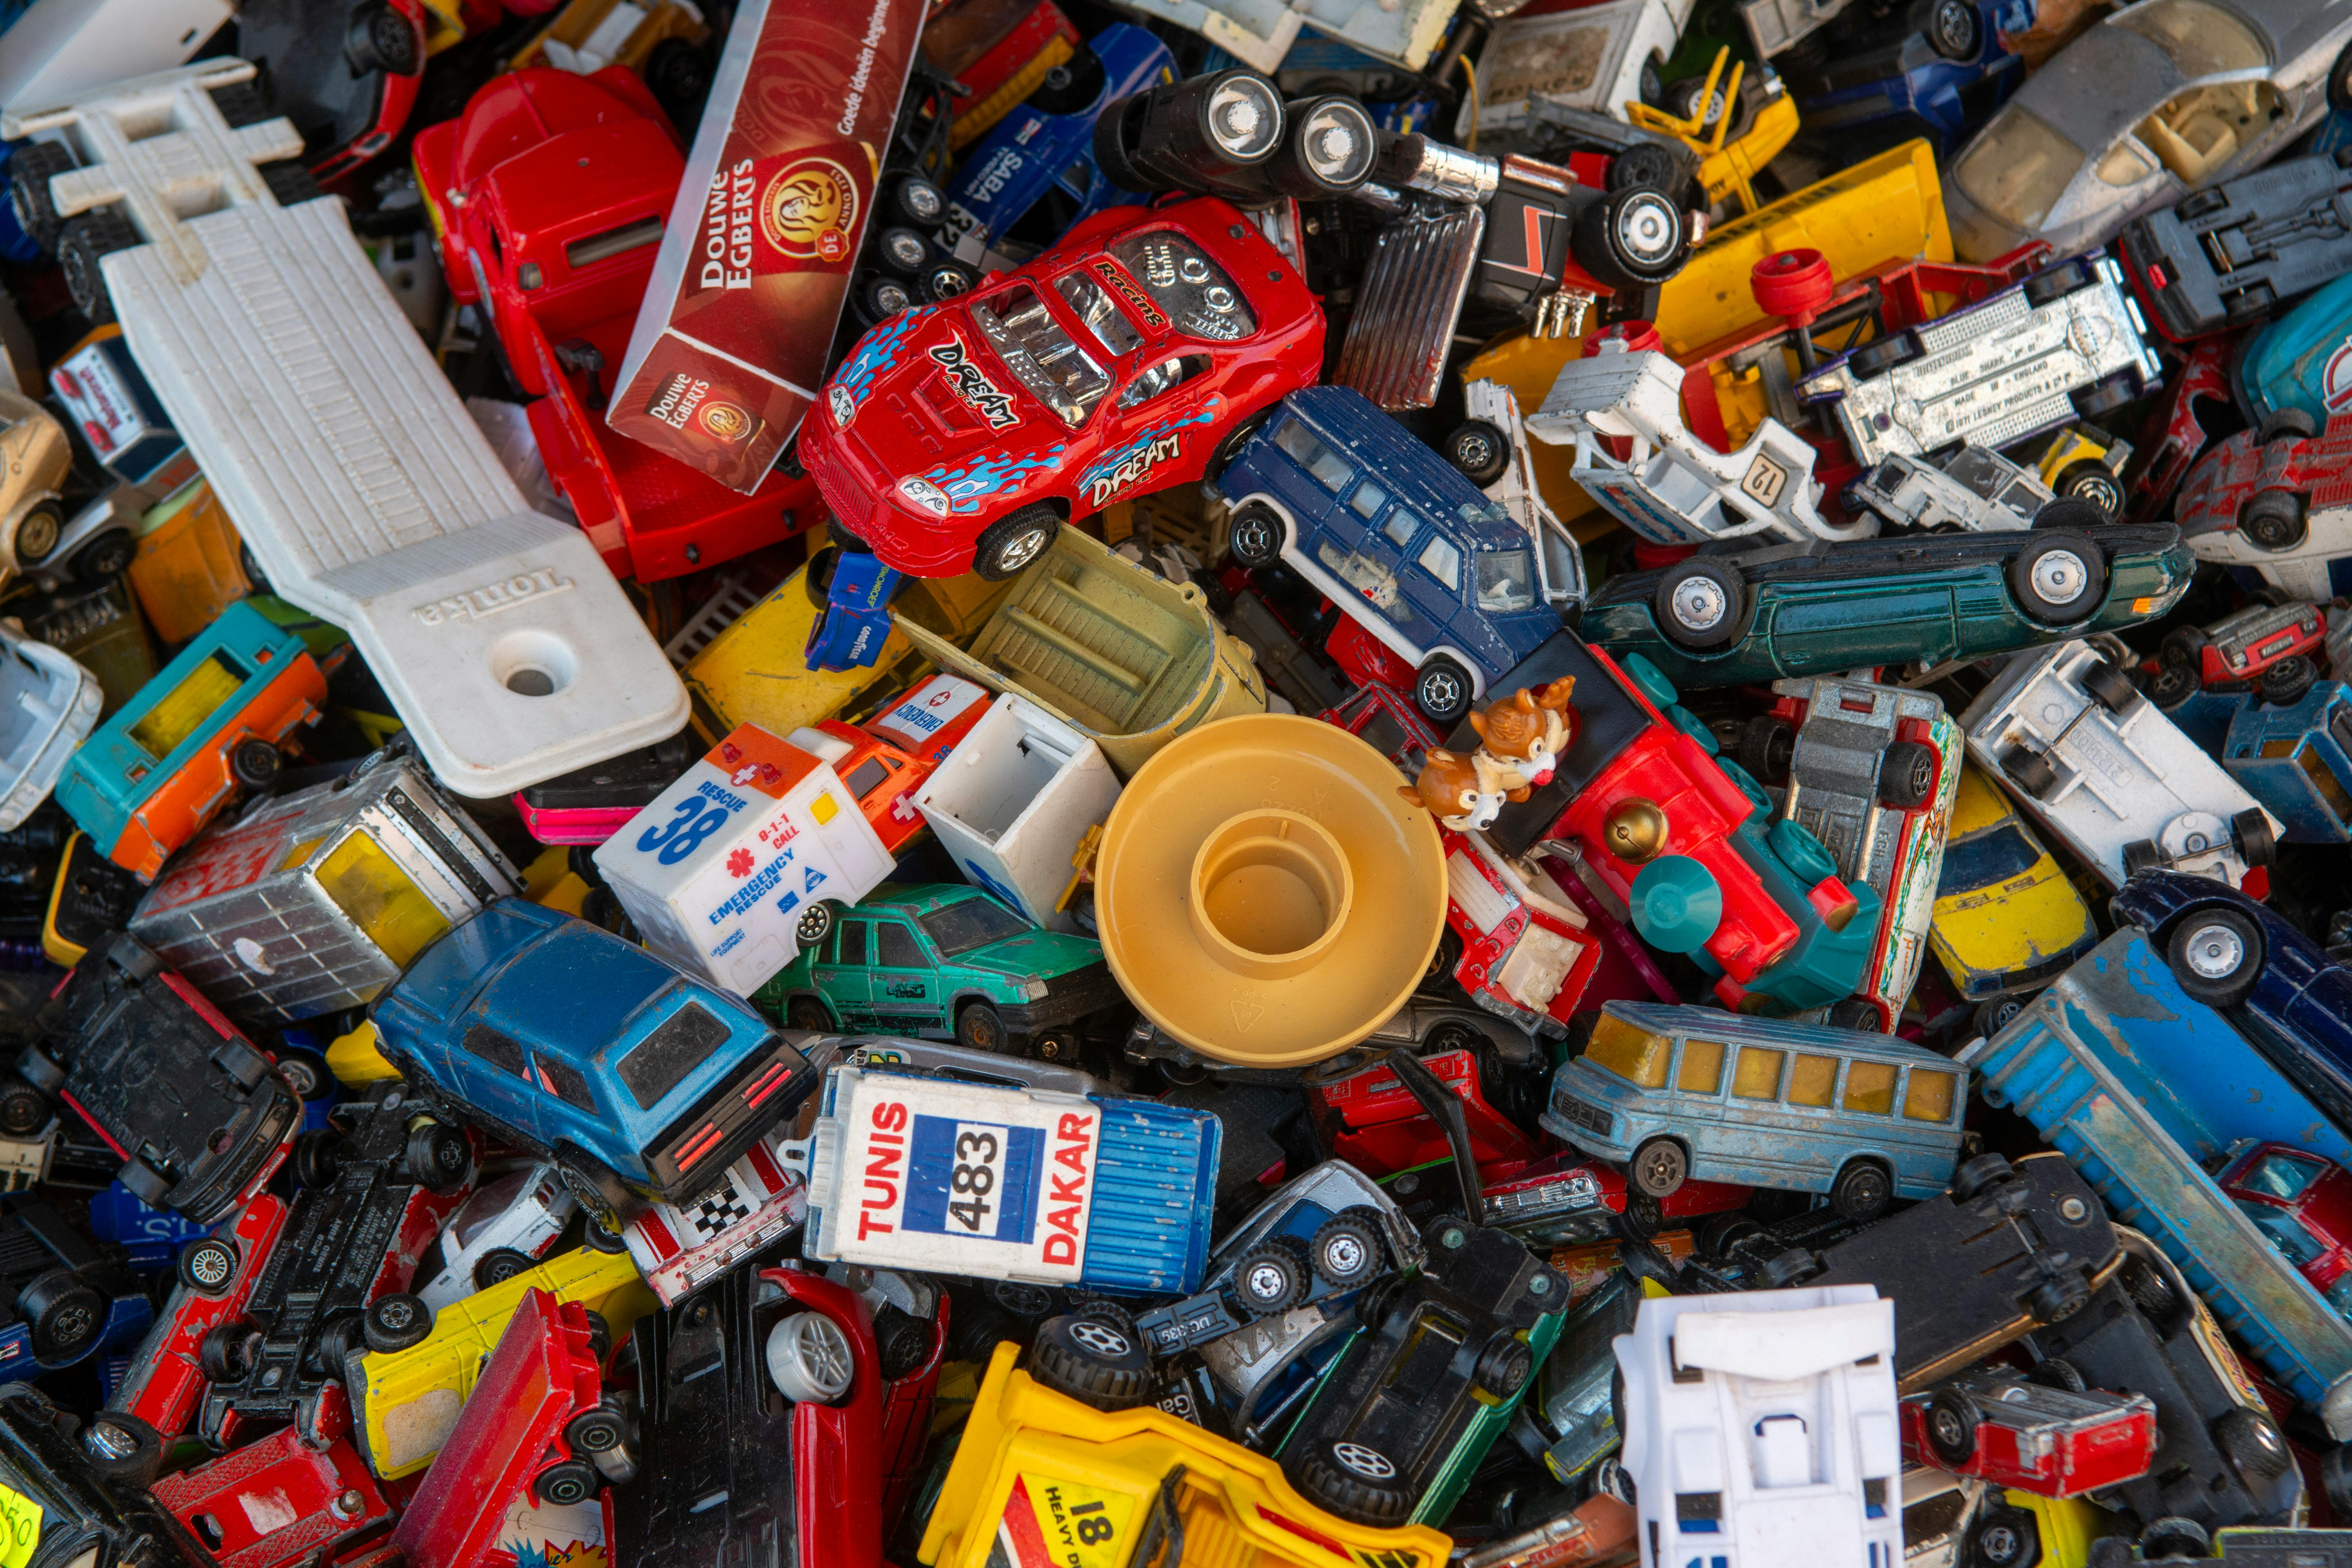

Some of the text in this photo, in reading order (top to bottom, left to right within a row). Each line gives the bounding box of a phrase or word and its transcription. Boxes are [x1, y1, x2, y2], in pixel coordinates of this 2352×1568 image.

[837, 92, 862, 135] Goede
[972, 152, 1023, 203] SABA
[726, 158, 757, 289] EGBERTS
[839, 194, 853, 227] ANNO
[941, 209, 973, 247] 32
[824, 234, 839, 254] DE
[1093, 261, 1166, 327] Racing
[929, 331, 1020, 430] DREAM
[943, 375, 978, 410] Racing car
[666, 379, 710, 430] EGBERTS
[1092, 432, 1181, 508] DREAM
[1136, 471, 1154, 485] car
[1752, 463, 1777, 497] 12
[413, 569, 575, 626] Tonka
[867, 568, 889, 603] MONROE
[893, 703, 944, 732] EMERGENCY
[697, 780, 748, 813] RESCUE
[637, 796, 729, 865] 38
[772, 825, 800, 850] CALL
[708, 847, 795, 926] EMERGENCY
[735, 875, 782, 916] RESCUE
[710, 928, 743, 957] LIFE SUPPORT
[719, 933, 746, 957] EQUIPMENT
[857, 1102, 908, 1241] TUNIS
[949, 1131, 998, 1232] 483
[1042, 1112, 1093, 1266] DAKAR
[313, 1245, 330, 1273] TURBO
[1044, 1486, 1076, 1548] HEAVY
[1069, 1500, 1114, 1546] 18
